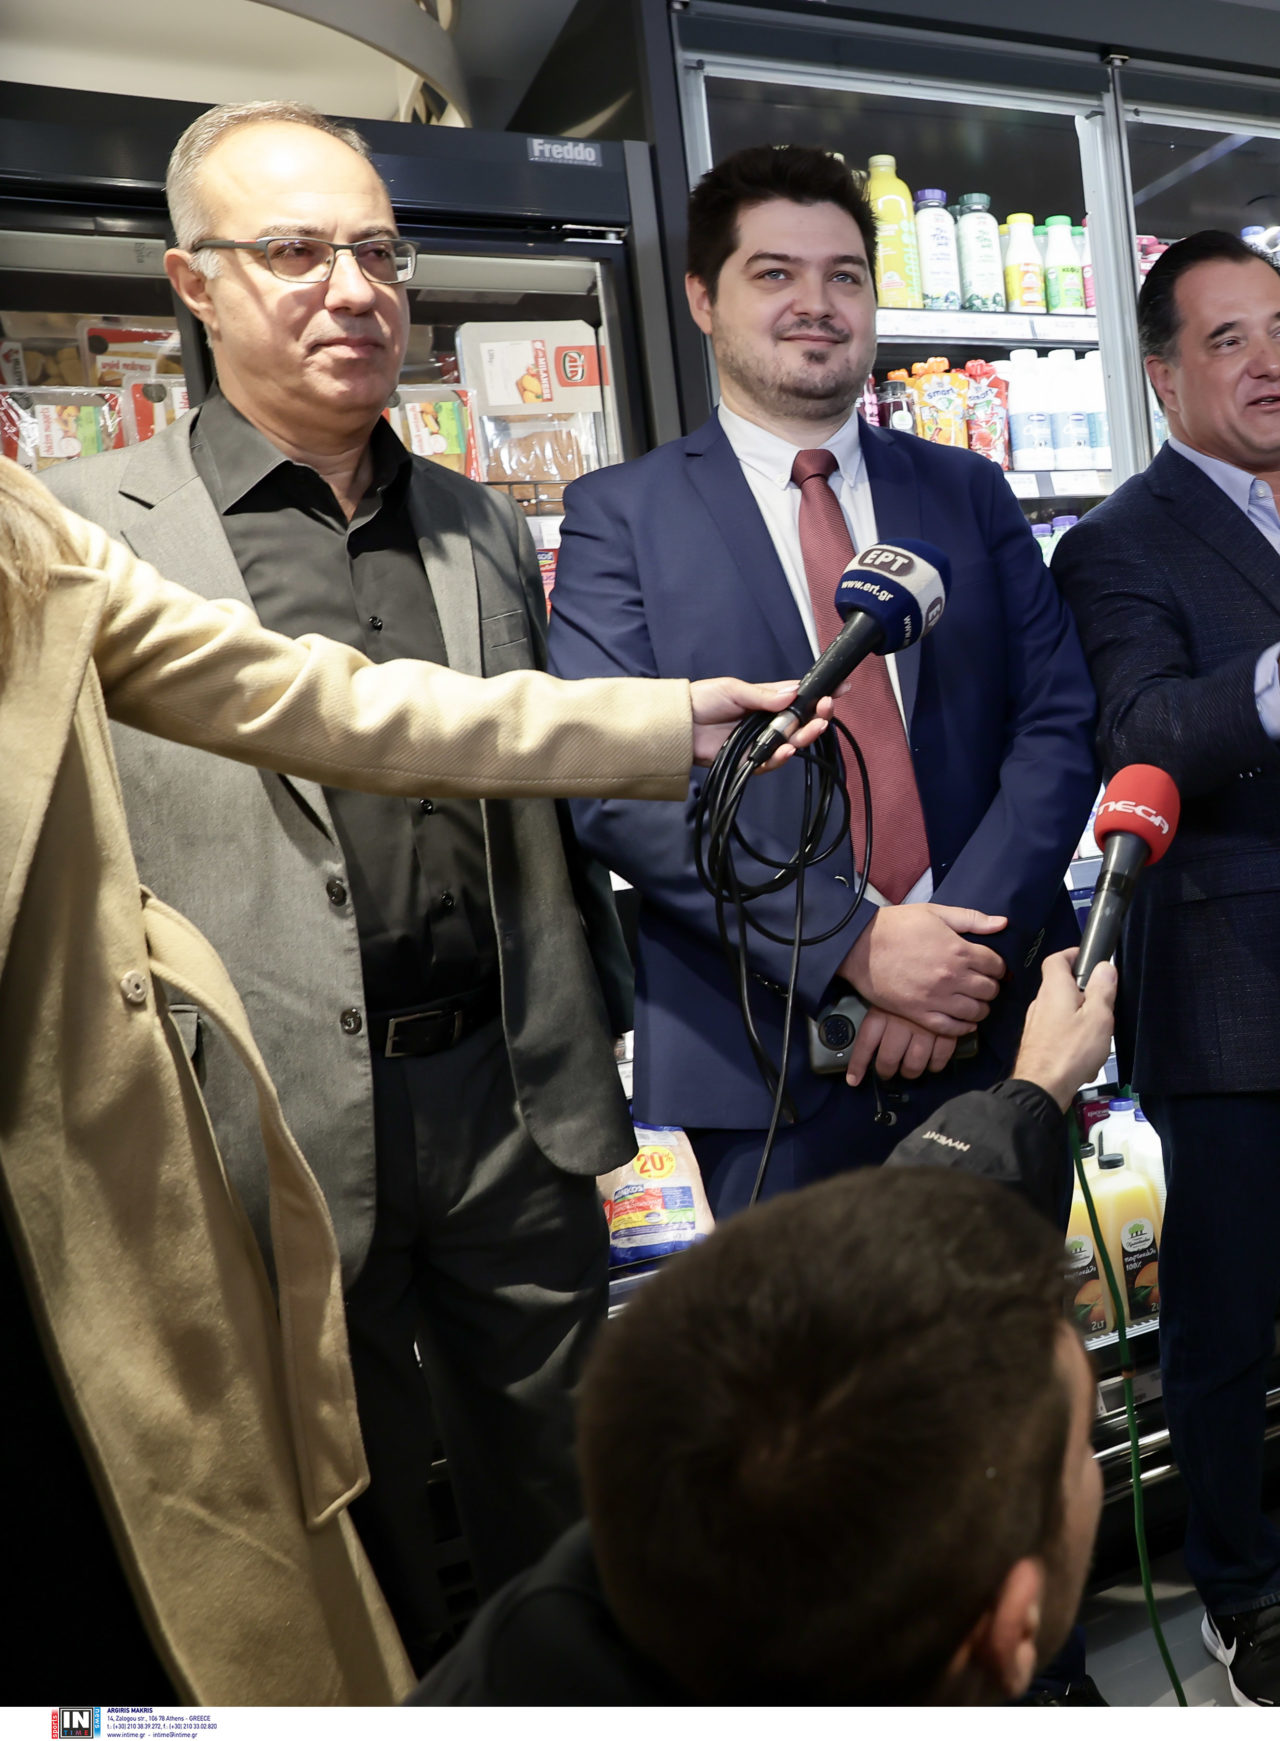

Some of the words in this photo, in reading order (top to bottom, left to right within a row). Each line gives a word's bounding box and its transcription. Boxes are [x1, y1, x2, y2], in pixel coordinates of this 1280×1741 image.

[532, 139, 596, 161] Freddo
[862, 550, 910, 571] ΕΡΤ
[841, 580, 893, 601] www.ert.gr
[1091, 1320, 1105, 1331] 2LT
